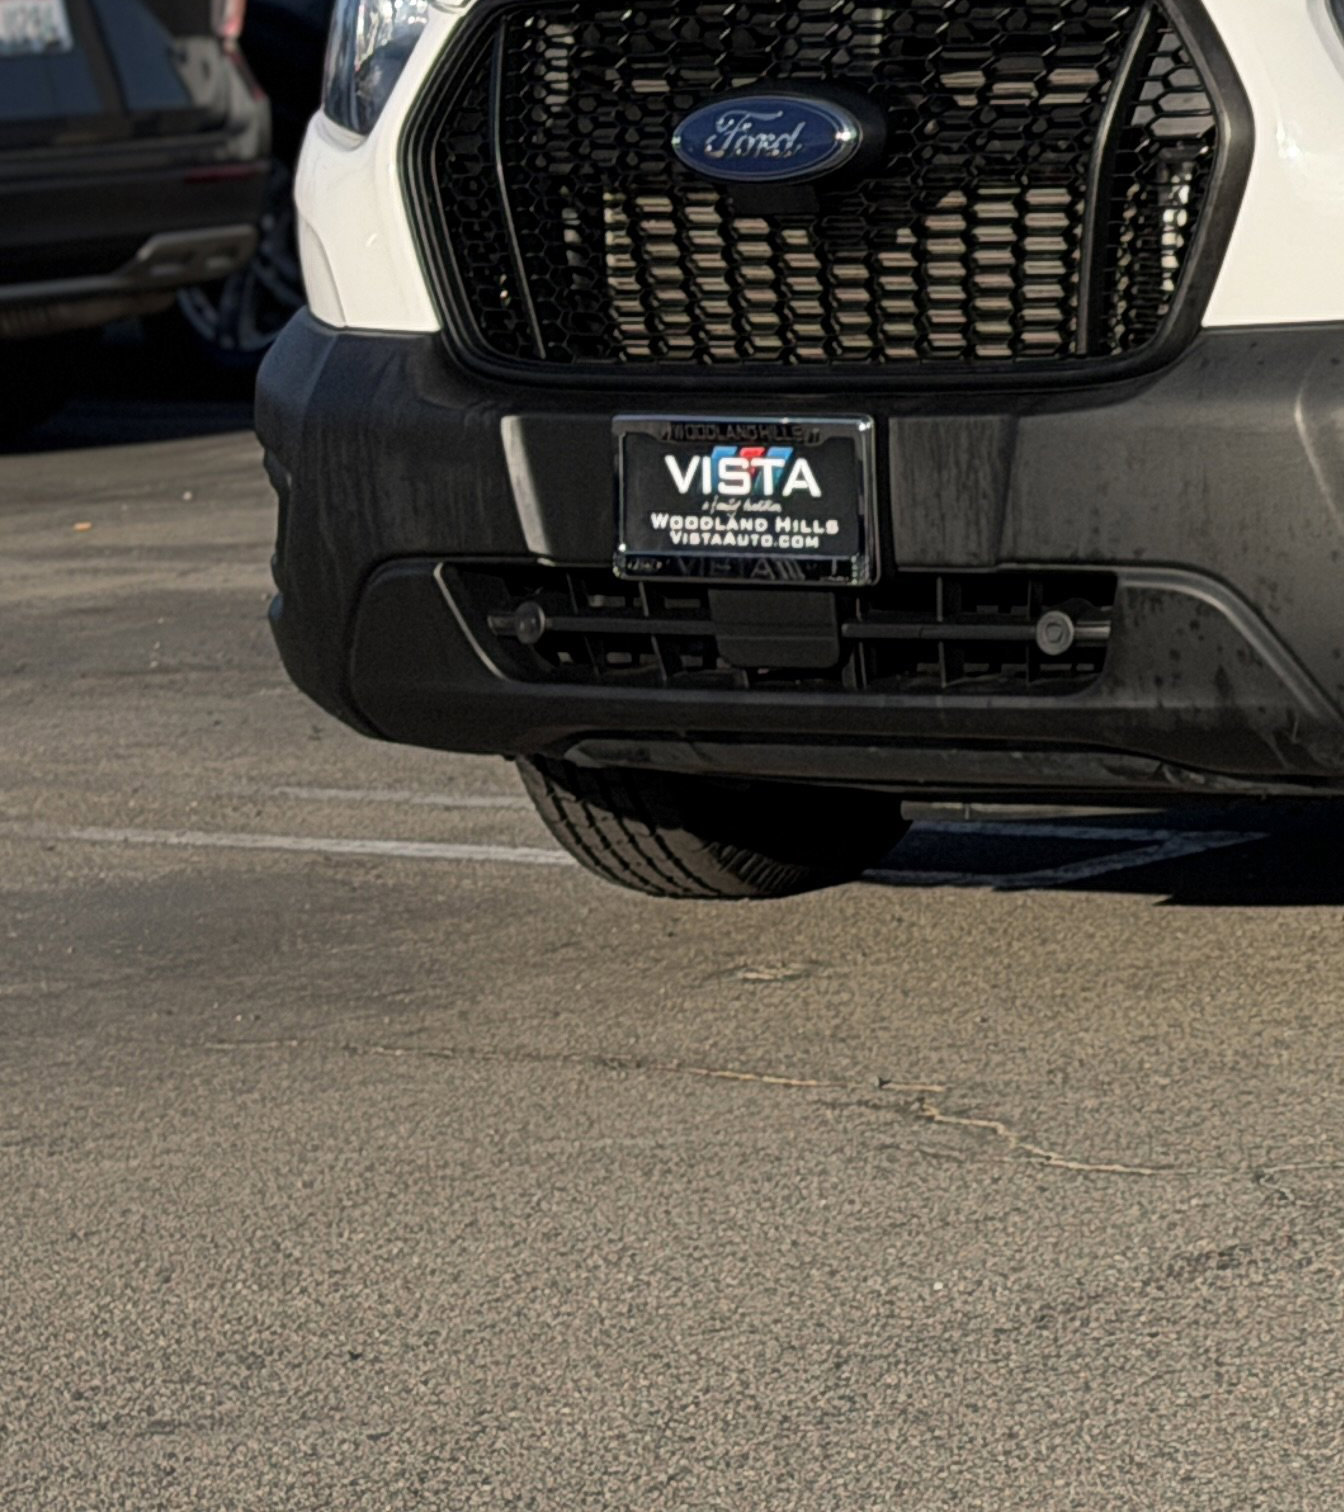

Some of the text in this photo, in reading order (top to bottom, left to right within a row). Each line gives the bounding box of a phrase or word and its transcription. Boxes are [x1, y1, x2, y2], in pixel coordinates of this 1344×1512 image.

[704, 109, 807, 159] Ford
[664, 454, 822, 498] VISTA
[650, 512, 840, 535] WOODLAND HILLS
